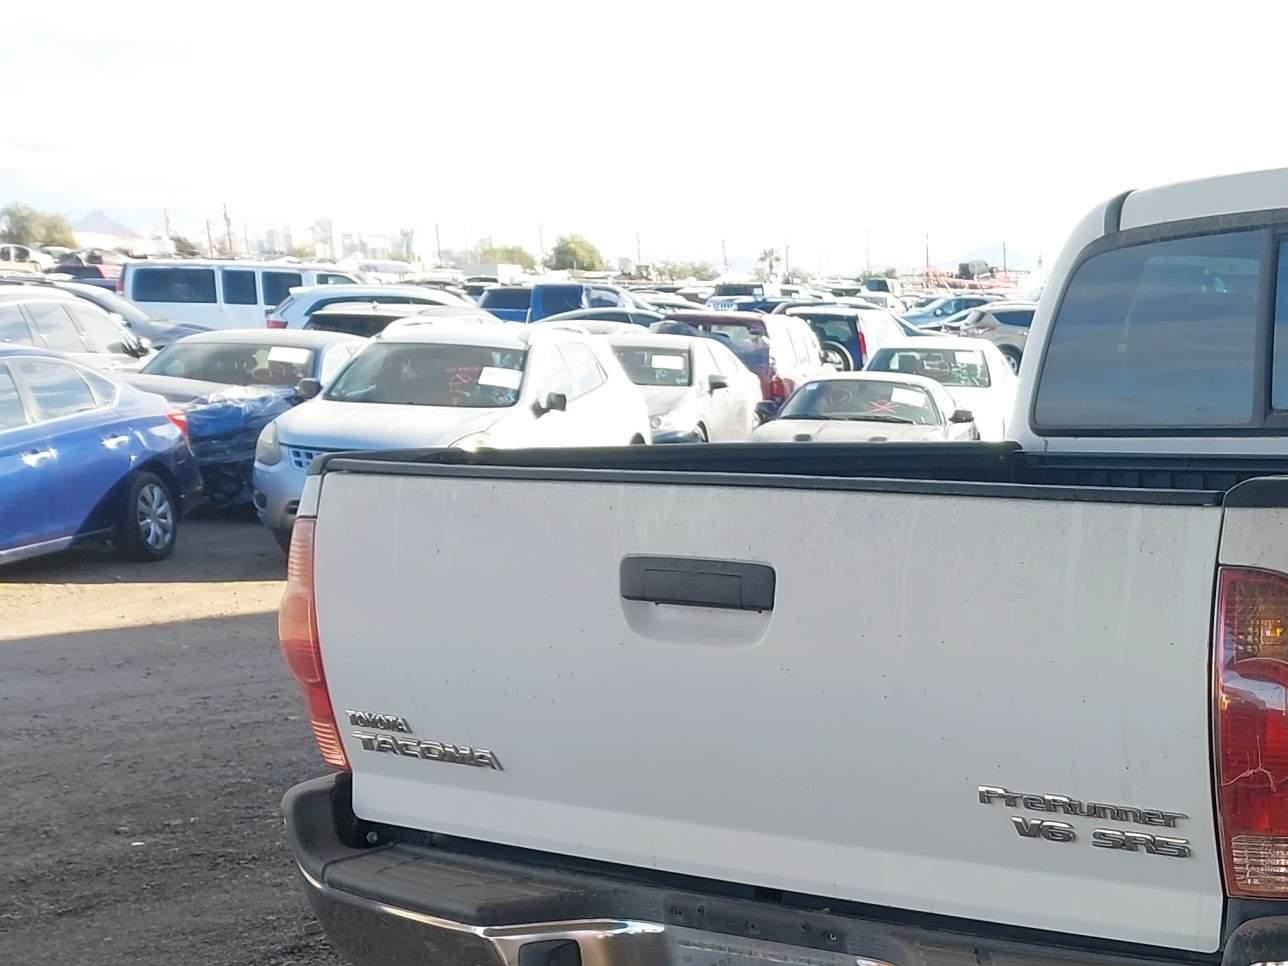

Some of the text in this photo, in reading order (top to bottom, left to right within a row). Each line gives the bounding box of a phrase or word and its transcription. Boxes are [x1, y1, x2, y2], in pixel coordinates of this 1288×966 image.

[345, 710, 413, 734] TOYOTA
[352, 730, 504, 772] TACOMA
[978, 785, 1190, 828] PreRunner
[1011, 816, 1192, 858] V6 SR5
